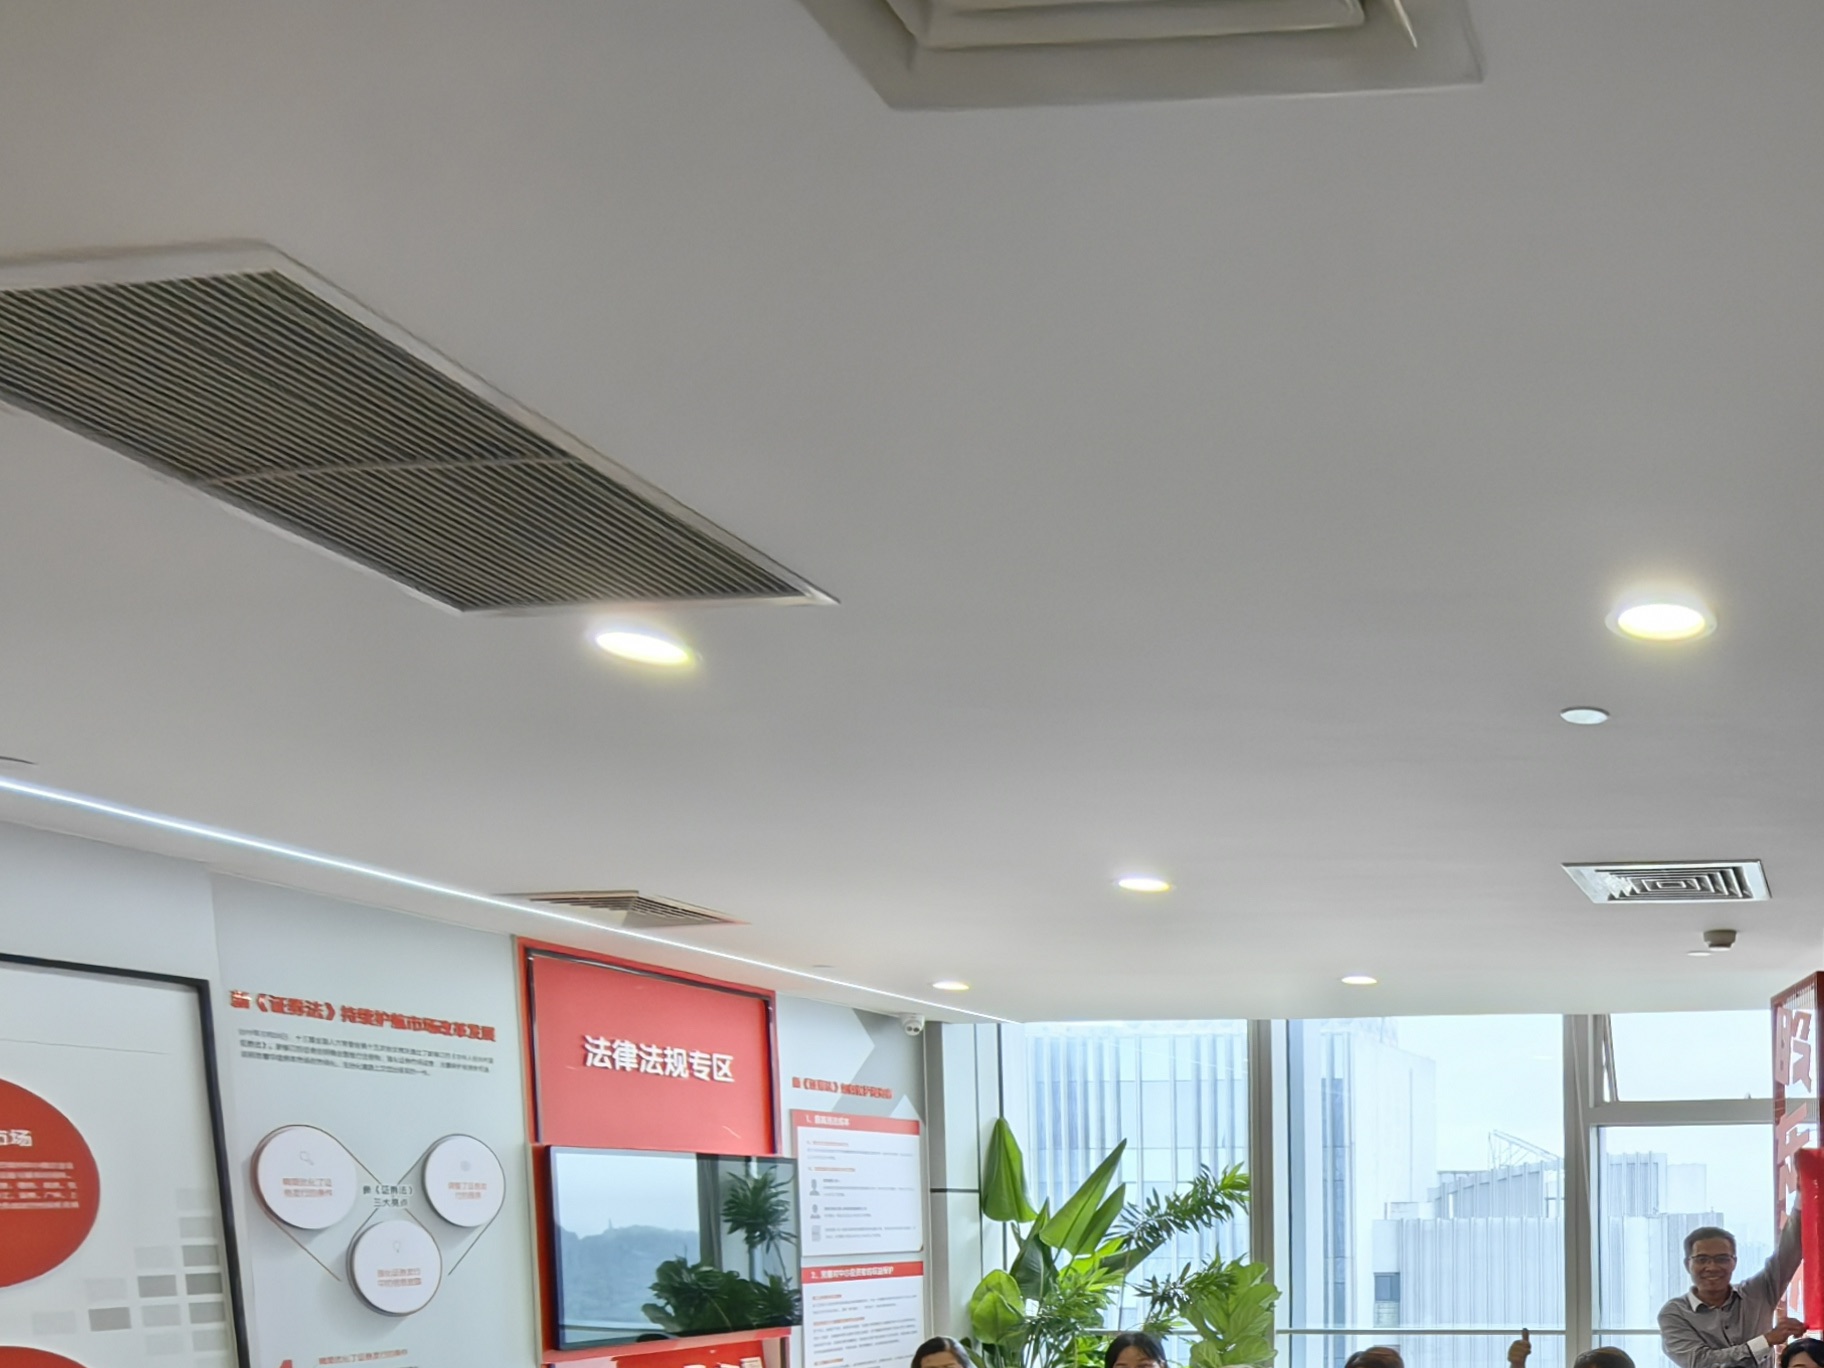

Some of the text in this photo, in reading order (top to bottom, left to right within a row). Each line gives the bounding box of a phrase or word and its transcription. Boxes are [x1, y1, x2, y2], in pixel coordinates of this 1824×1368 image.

[584, 1035, 734, 1084] 法律法规专区
